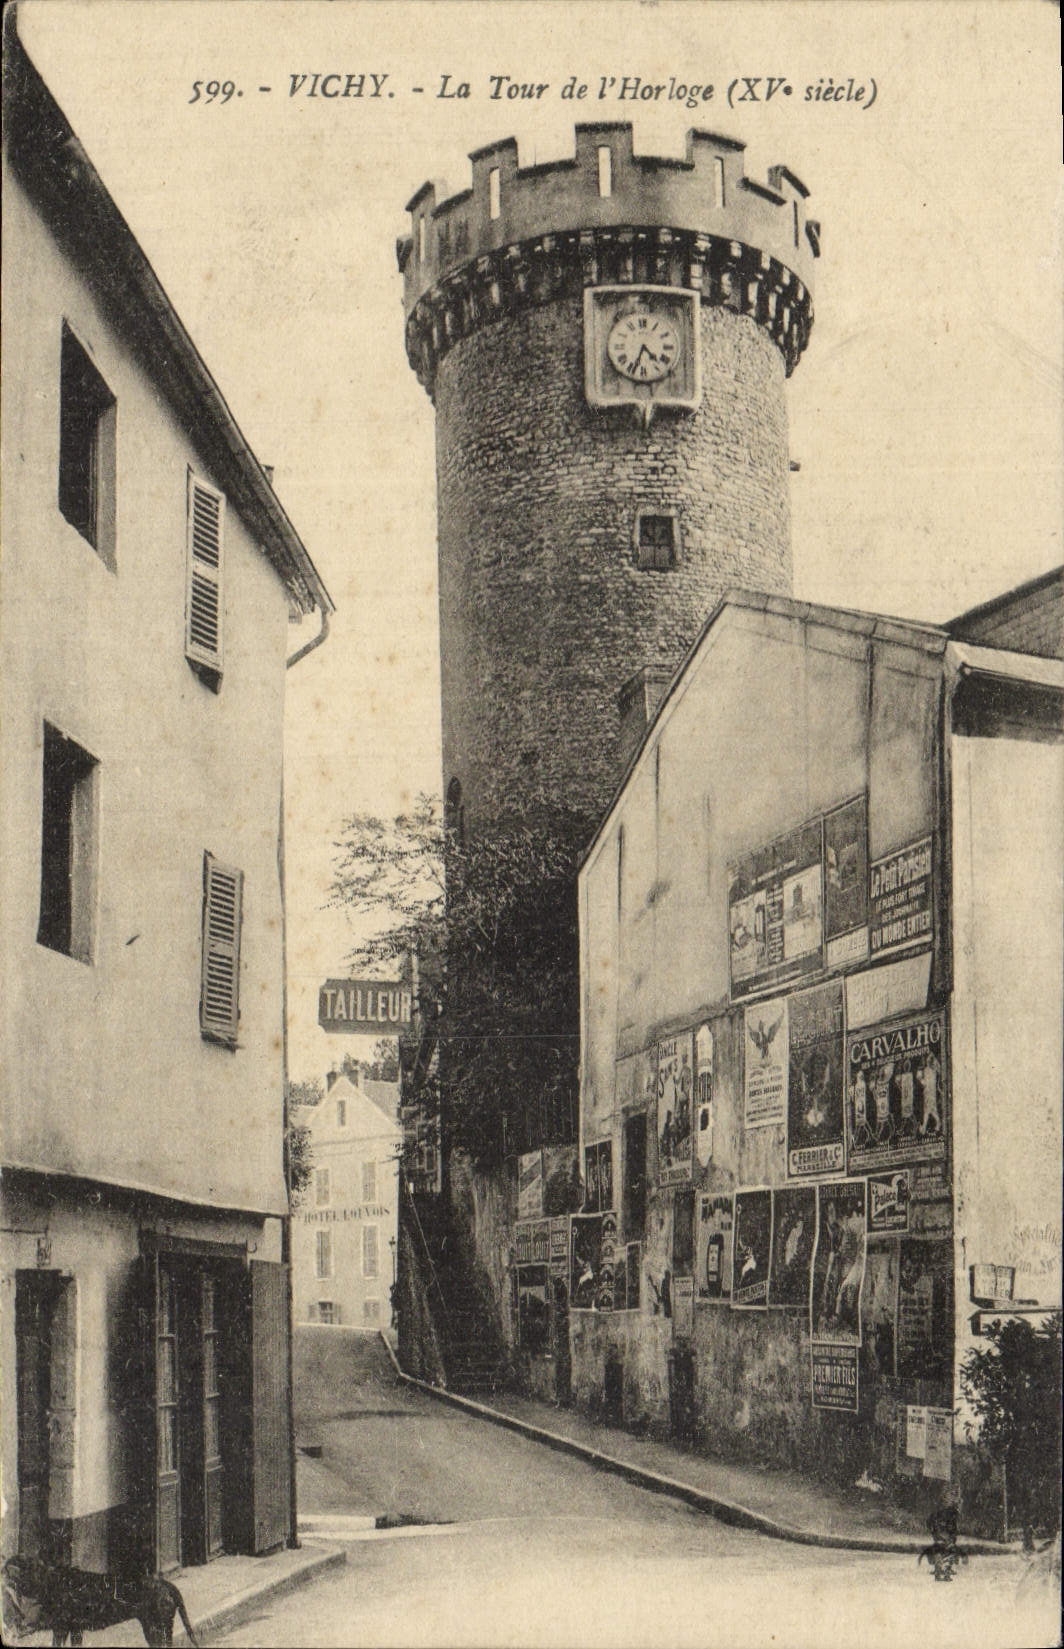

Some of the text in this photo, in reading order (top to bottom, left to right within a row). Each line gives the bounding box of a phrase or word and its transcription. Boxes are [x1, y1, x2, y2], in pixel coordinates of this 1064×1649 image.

[871, 846, 931, 899] Le Petit Parisien
[871, 927, 882, 949] DU
[882, 918, 907, 945] MONDE
[907, 909, 931, 936] ENTIER
[323, 988, 412, 1023] TAILLEUR
[850, 1020, 941, 1063] CARVALHO
[796, 1160, 837, 1173] MARSEILLE
[798, 1147, 829, 1165] FERRIER
[304, 1210, 339, 1224] HOTEL
